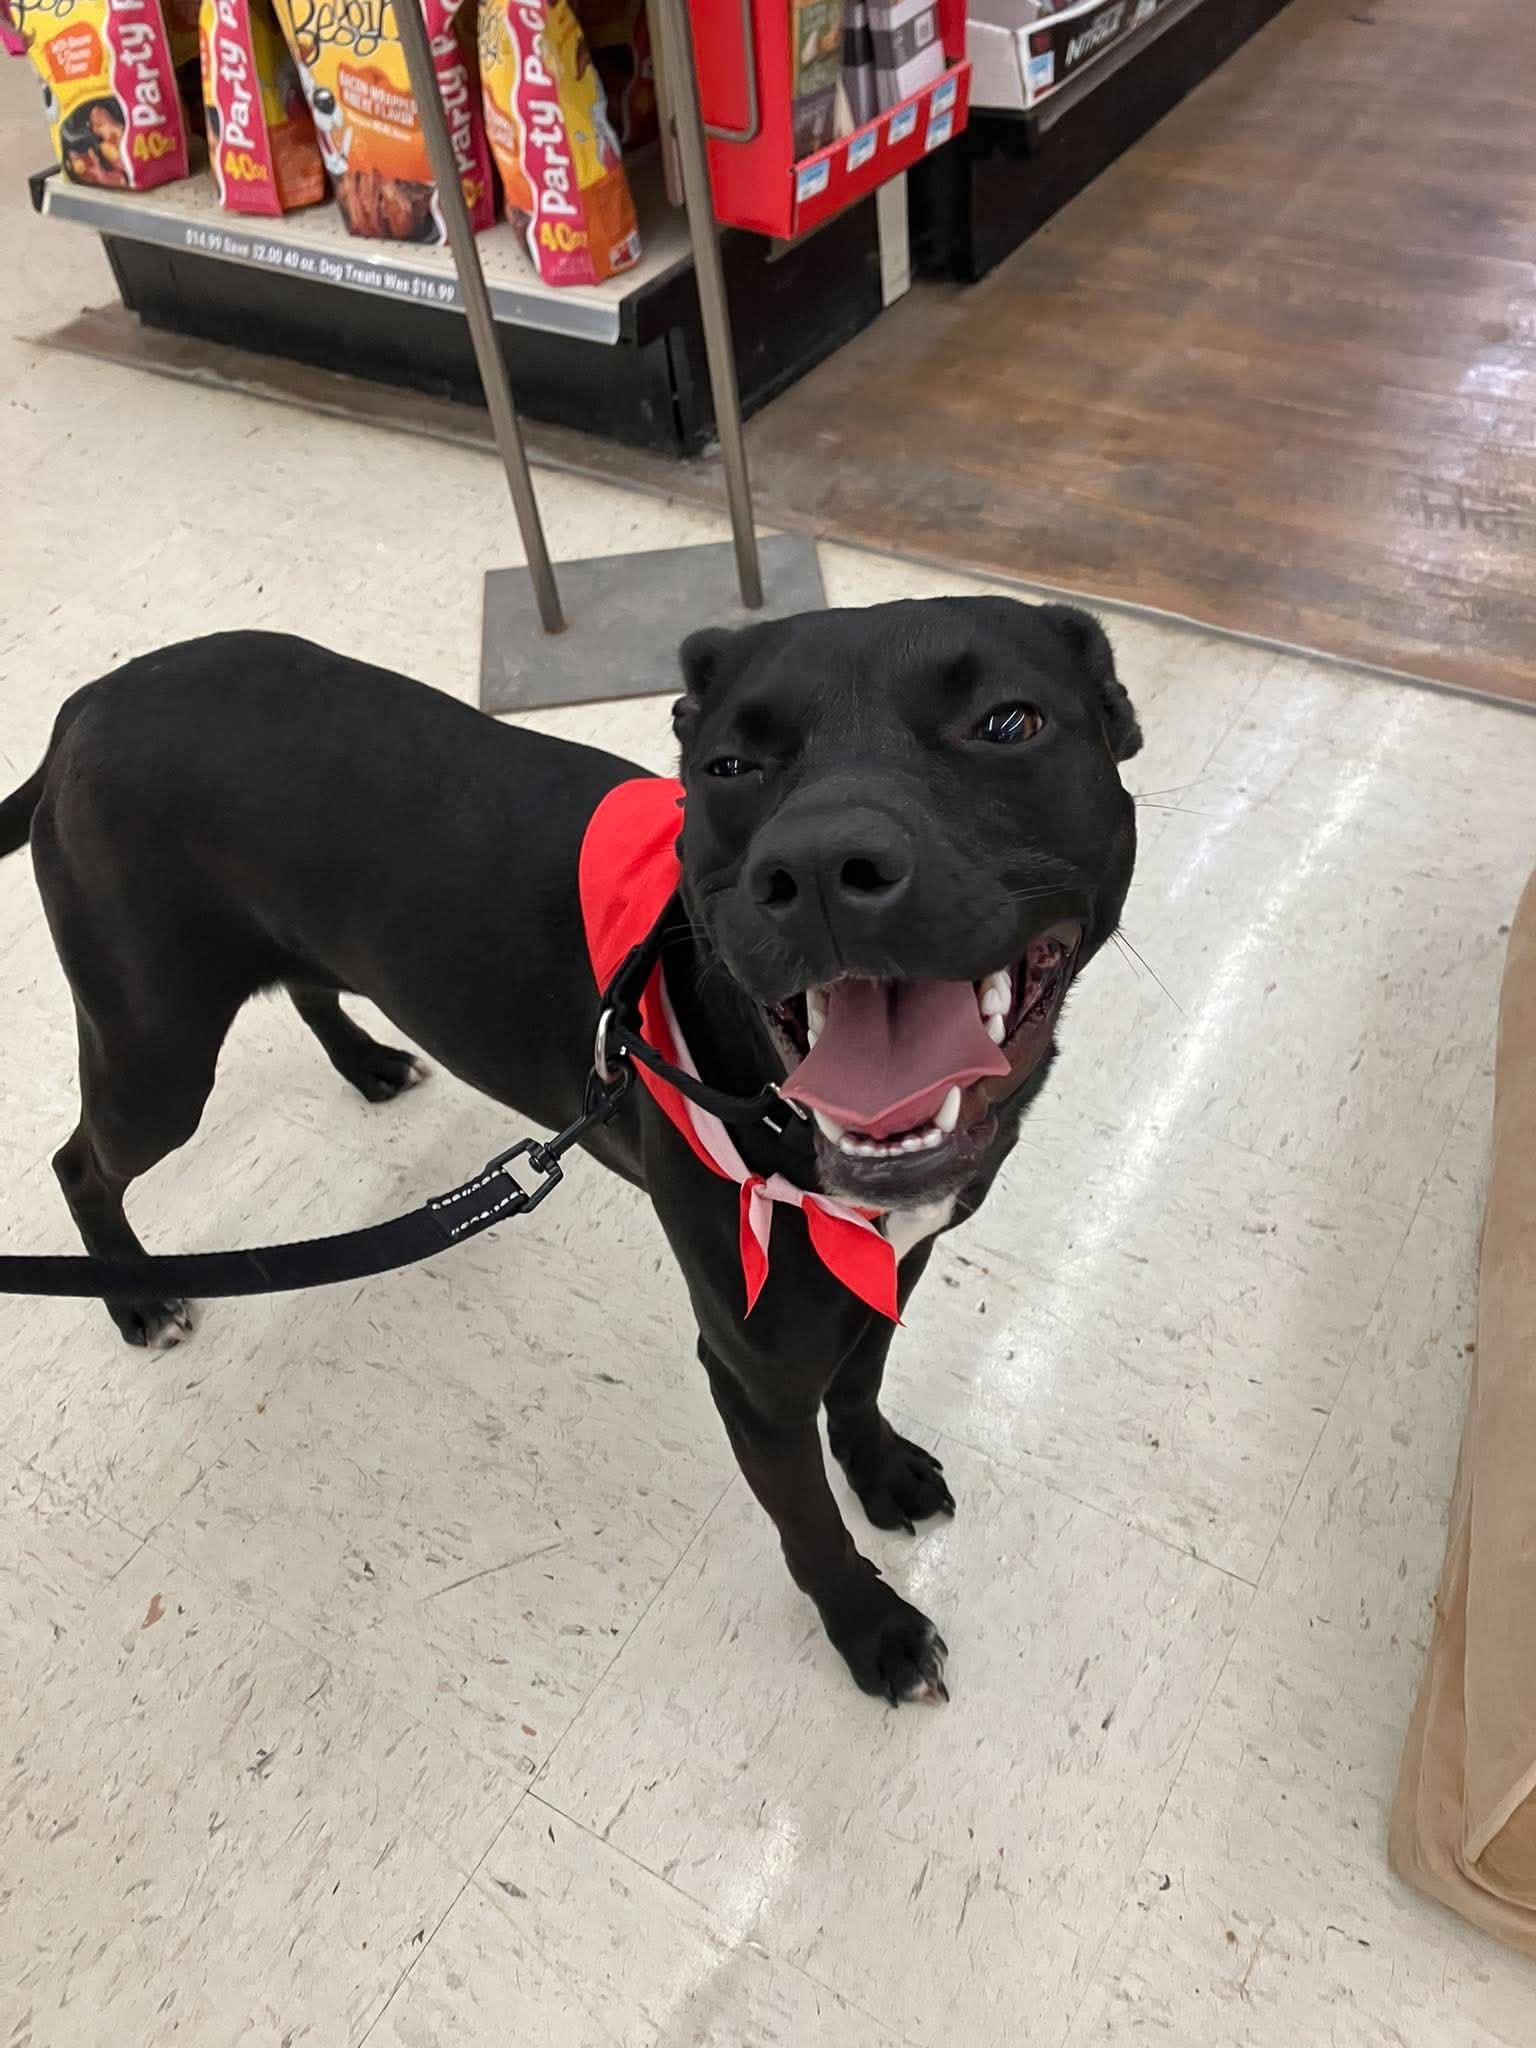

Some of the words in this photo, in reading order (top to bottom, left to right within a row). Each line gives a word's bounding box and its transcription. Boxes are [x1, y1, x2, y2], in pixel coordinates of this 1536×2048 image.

[118, 23, 166, 127] Party
[218, 38, 256, 149] Party
[527, 101, 577, 216] Party
[284, 249, 300, 269] 40
[319, 257, 343, 281] Dog
[344, 263, 382, 287] Treats
[383, 271, 410, 293] Was
[411, 277, 455, 303] $16.99
